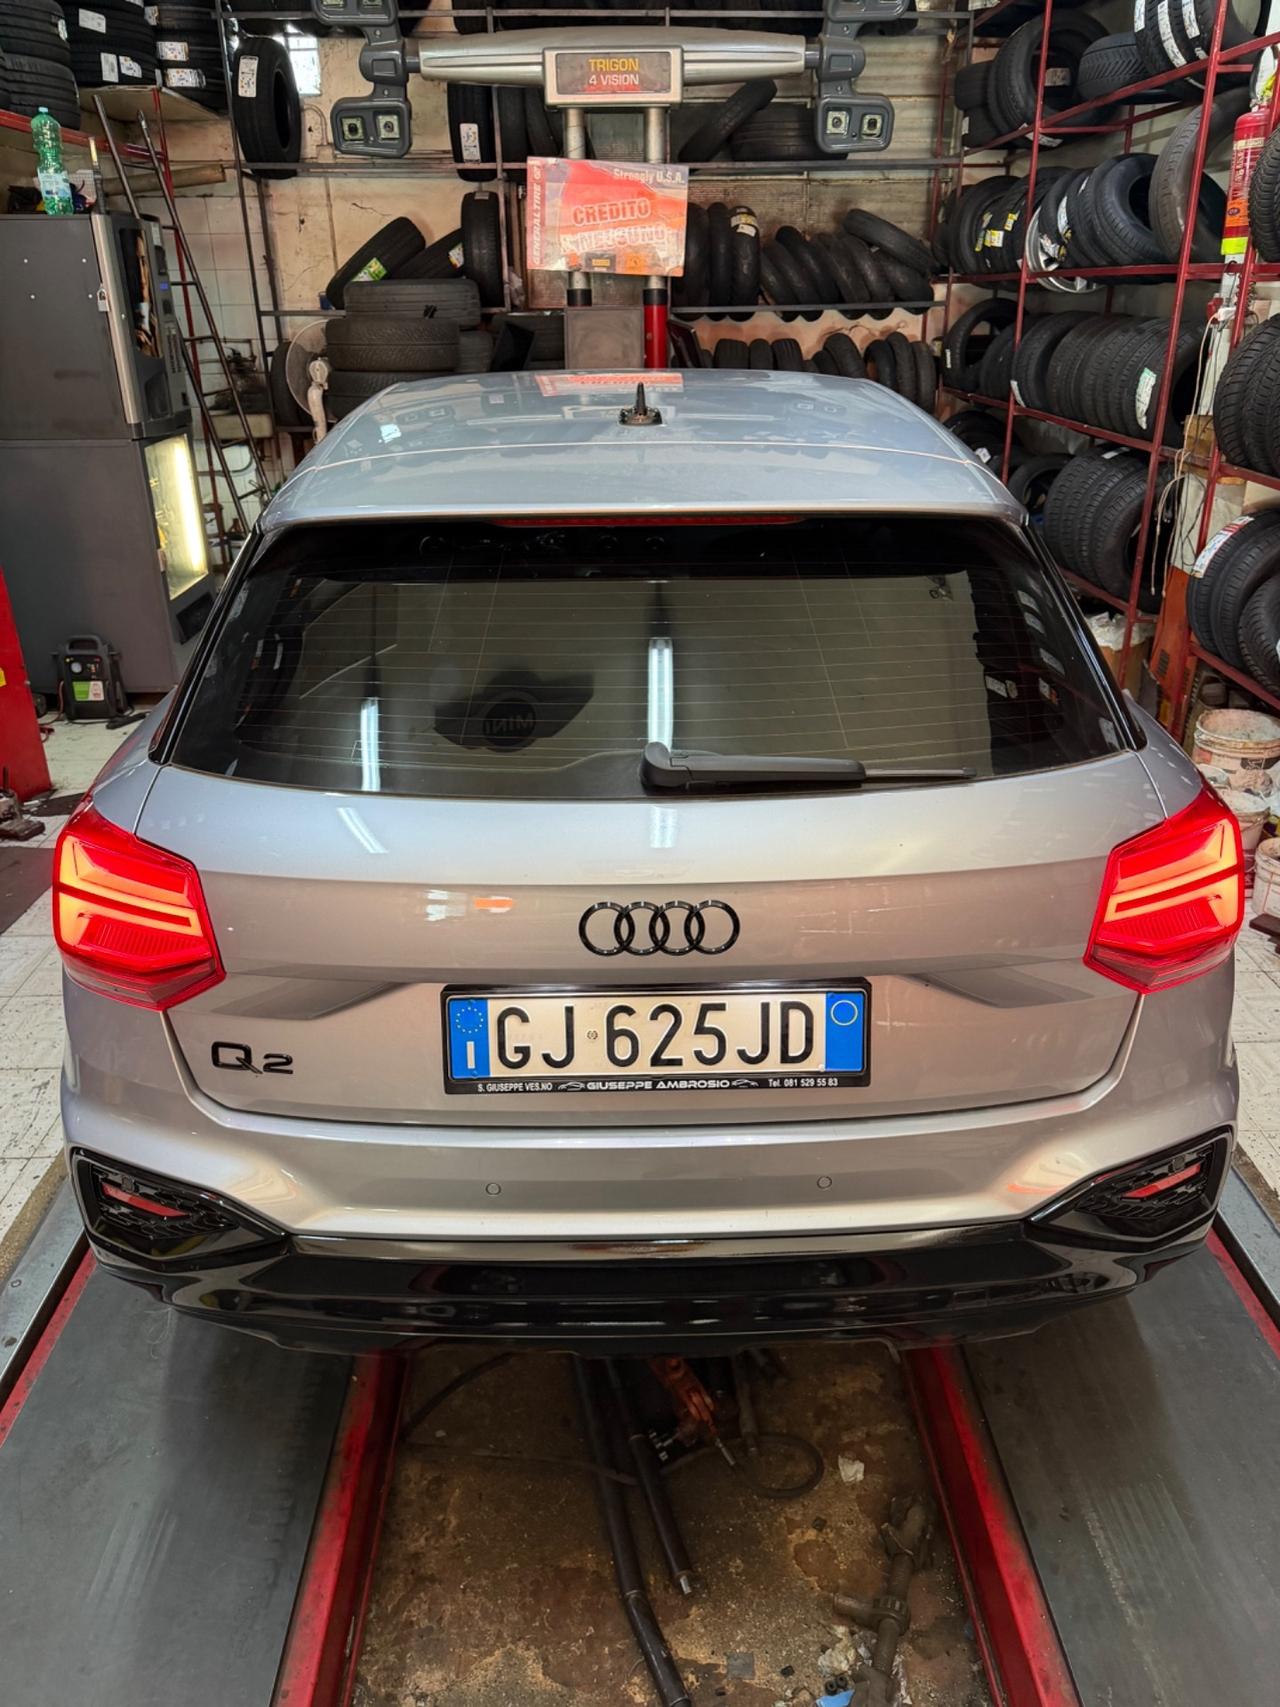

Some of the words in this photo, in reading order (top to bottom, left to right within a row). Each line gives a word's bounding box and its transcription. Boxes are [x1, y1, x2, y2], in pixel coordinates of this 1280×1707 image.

[589, 58, 639, 71] TRIGON
[589, 74, 597, 86] 4
[600, 74, 639, 86] VISION
[613, 168, 655, 185] Strongly
[656, 170, 685, 184] U.S.A.
[572, 199, 650, 226] CREDITO
[497, 1005, 575, 1069] GJ
[211, 1041, 293, 1074] Q2
[478, 1083, 485, 1092] S.
[486, 1082, 524, 1092] GIUSEPPE
[586, 1081, 653, 1091] GIUSEPPE
[656, 1079, 730, 1090] AMBROSIO
[783, 1078, 798, 1087] 081
[800, 1078, 815, 1087] 529
[817, 1078, 827, 1087] 55
[828, 1077, 839, 1087] 83
